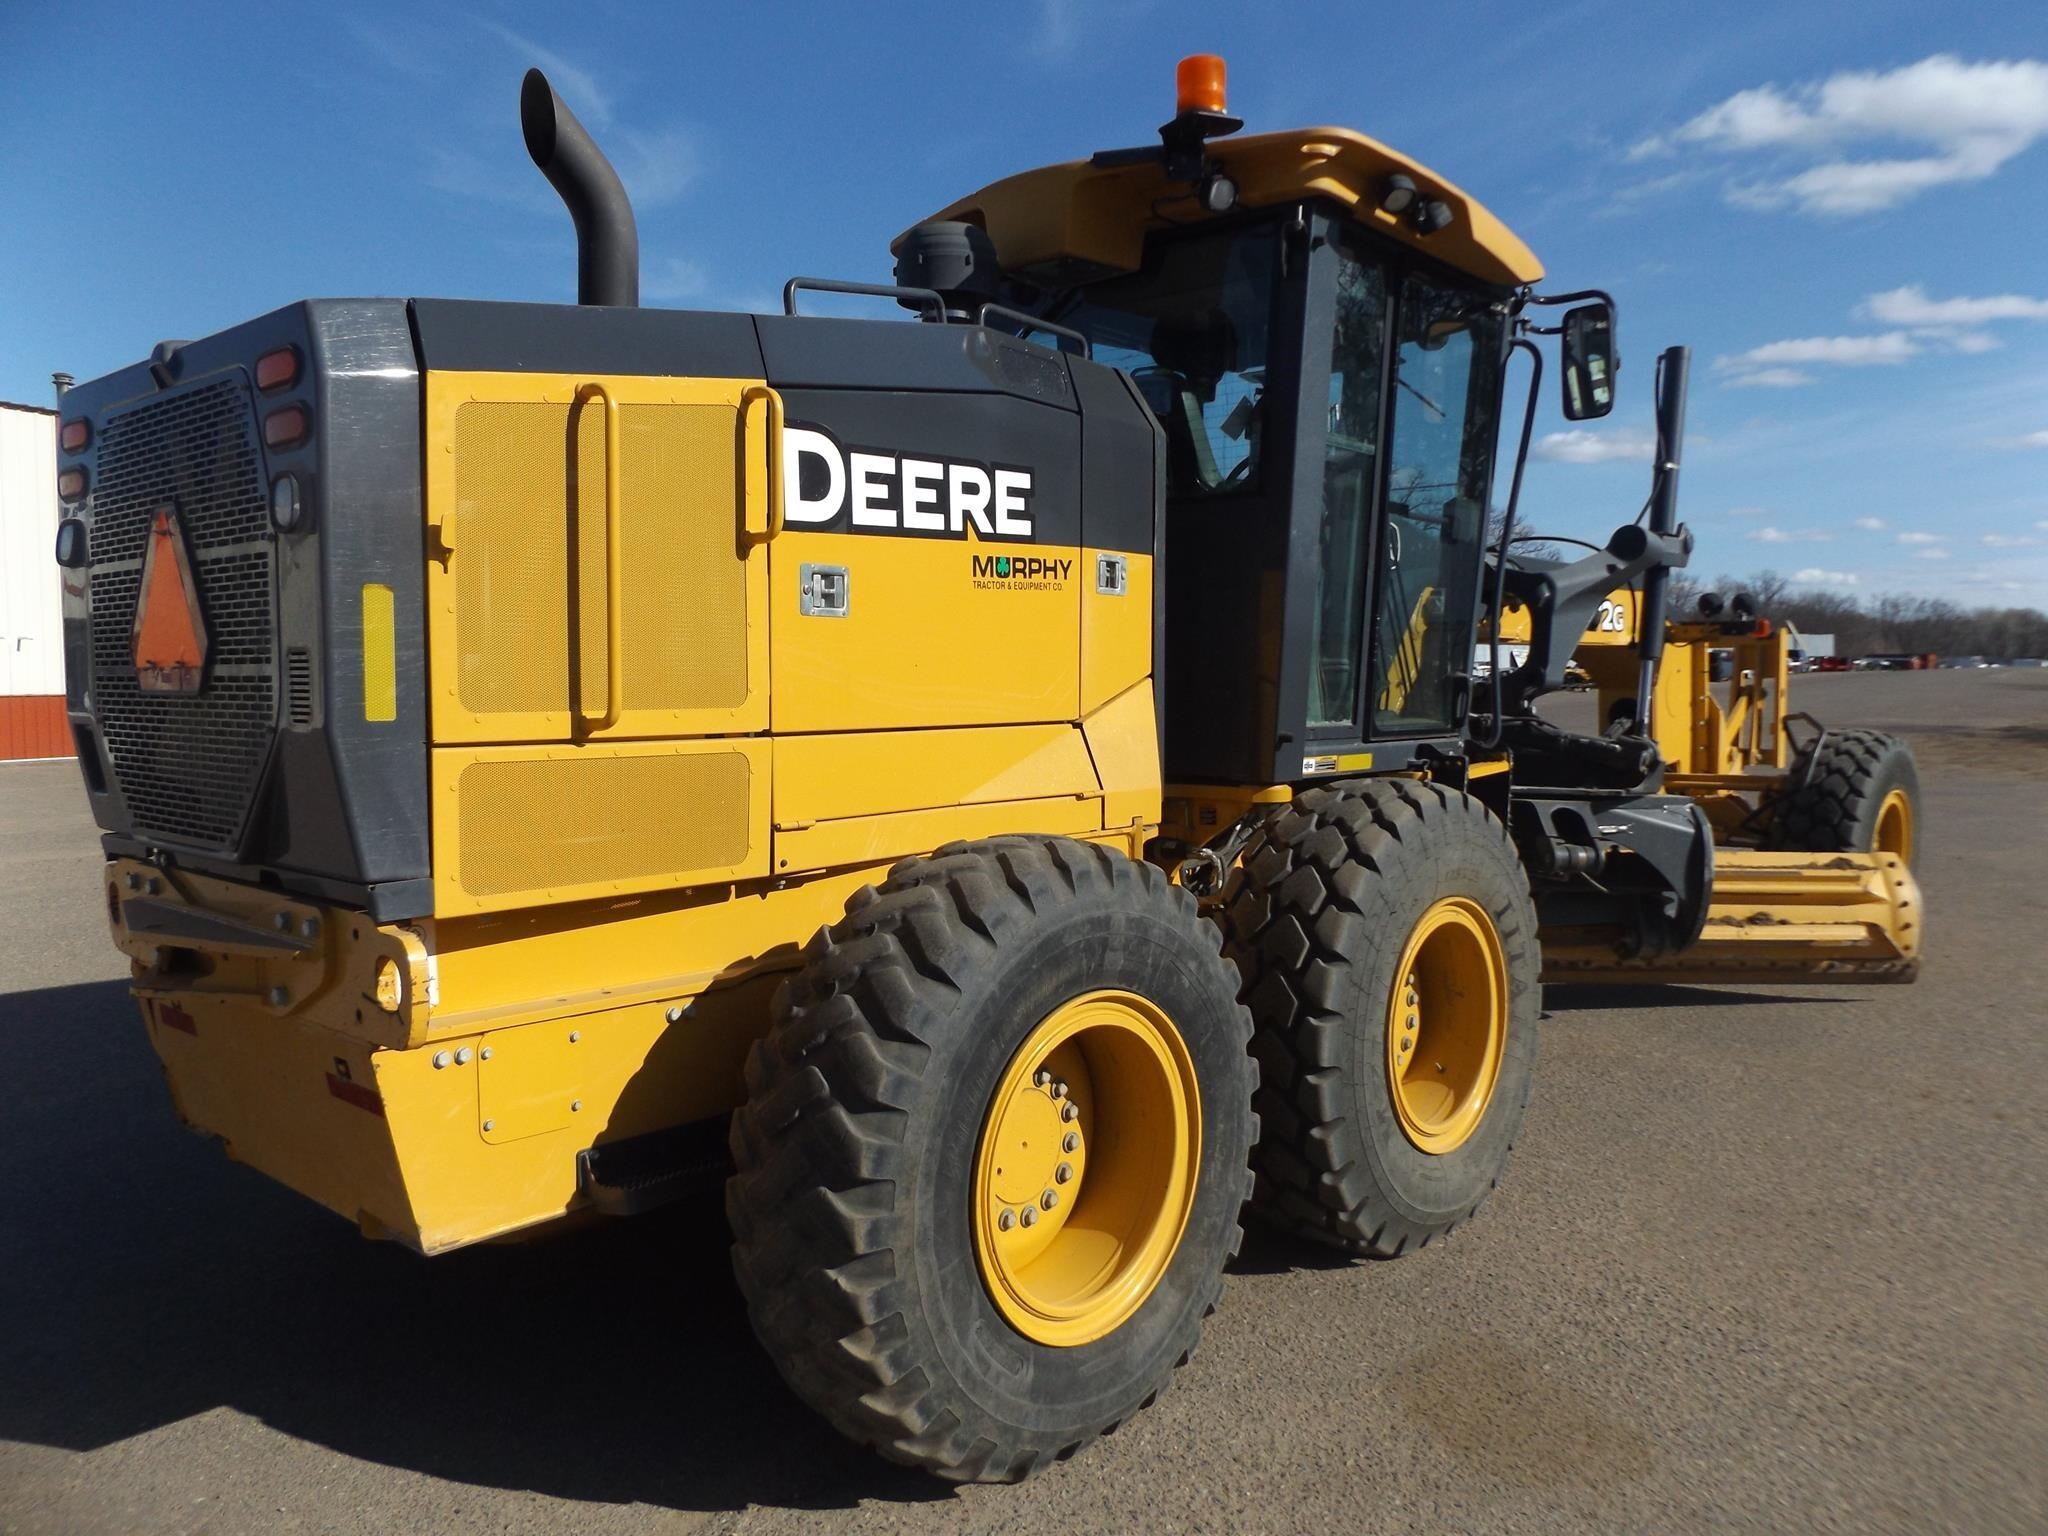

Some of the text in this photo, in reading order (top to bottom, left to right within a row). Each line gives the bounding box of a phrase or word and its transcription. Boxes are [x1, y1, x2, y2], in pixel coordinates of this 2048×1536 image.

[783, 427, 1033, 536] DEERE
[972, 555, 1073, 580] MURPHY
[973, 580, 1064, 592] TRACTOR & EQUIPMENT CO.
